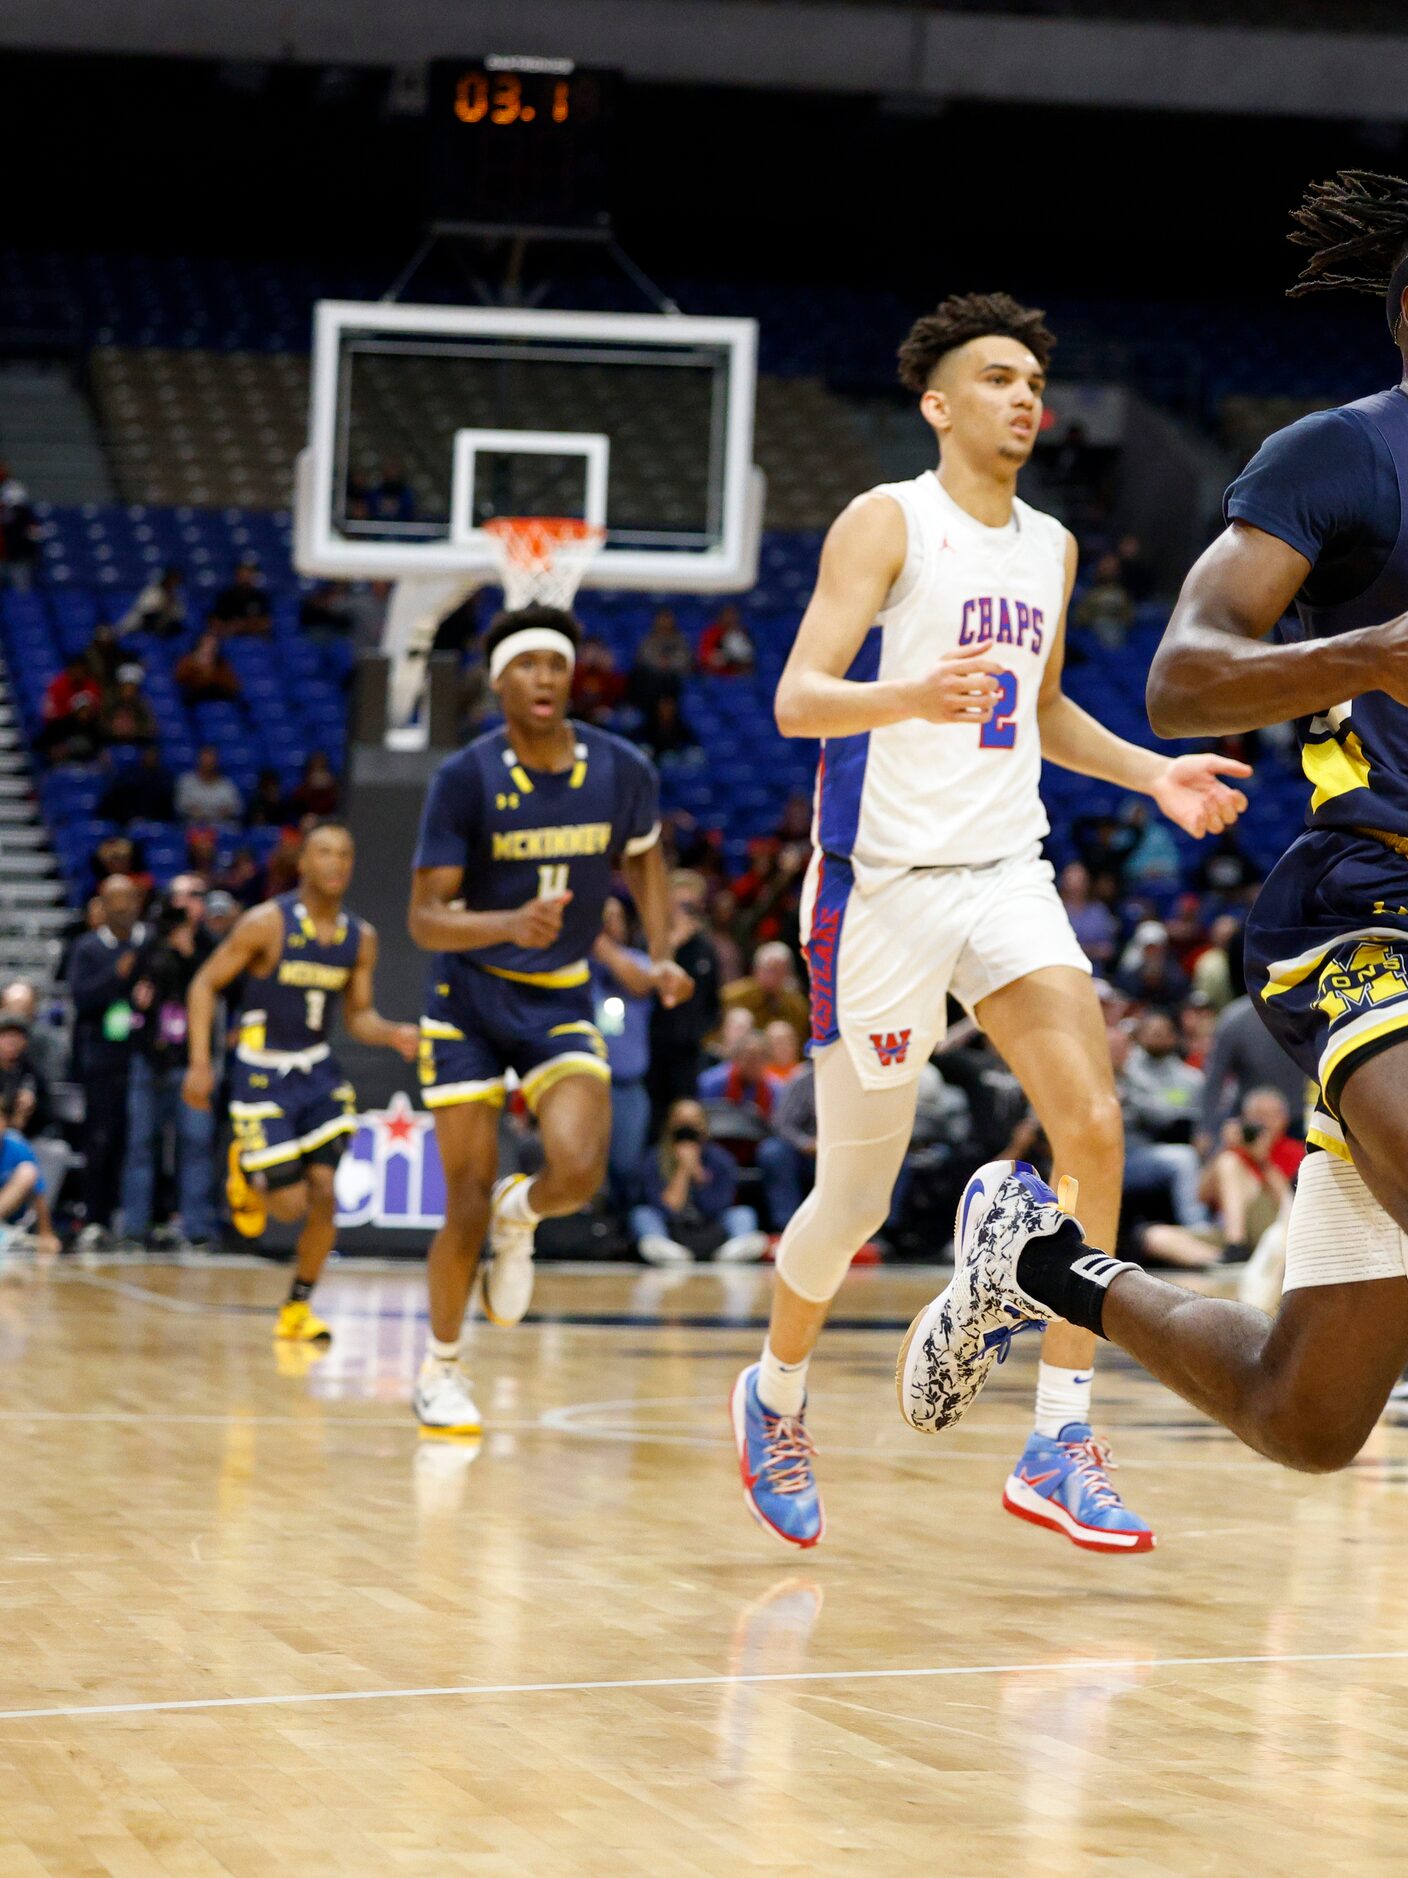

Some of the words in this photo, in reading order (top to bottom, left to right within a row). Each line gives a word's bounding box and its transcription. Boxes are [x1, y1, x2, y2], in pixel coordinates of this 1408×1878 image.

[454, 69, 569, 125] 03.1
[959, 596, 1044, 656] CHAPS
[980, 669, 1018, 750] 2
[492, 821, 612, 861] MCKINNEY
[869, 1028, 912, 1067] W
